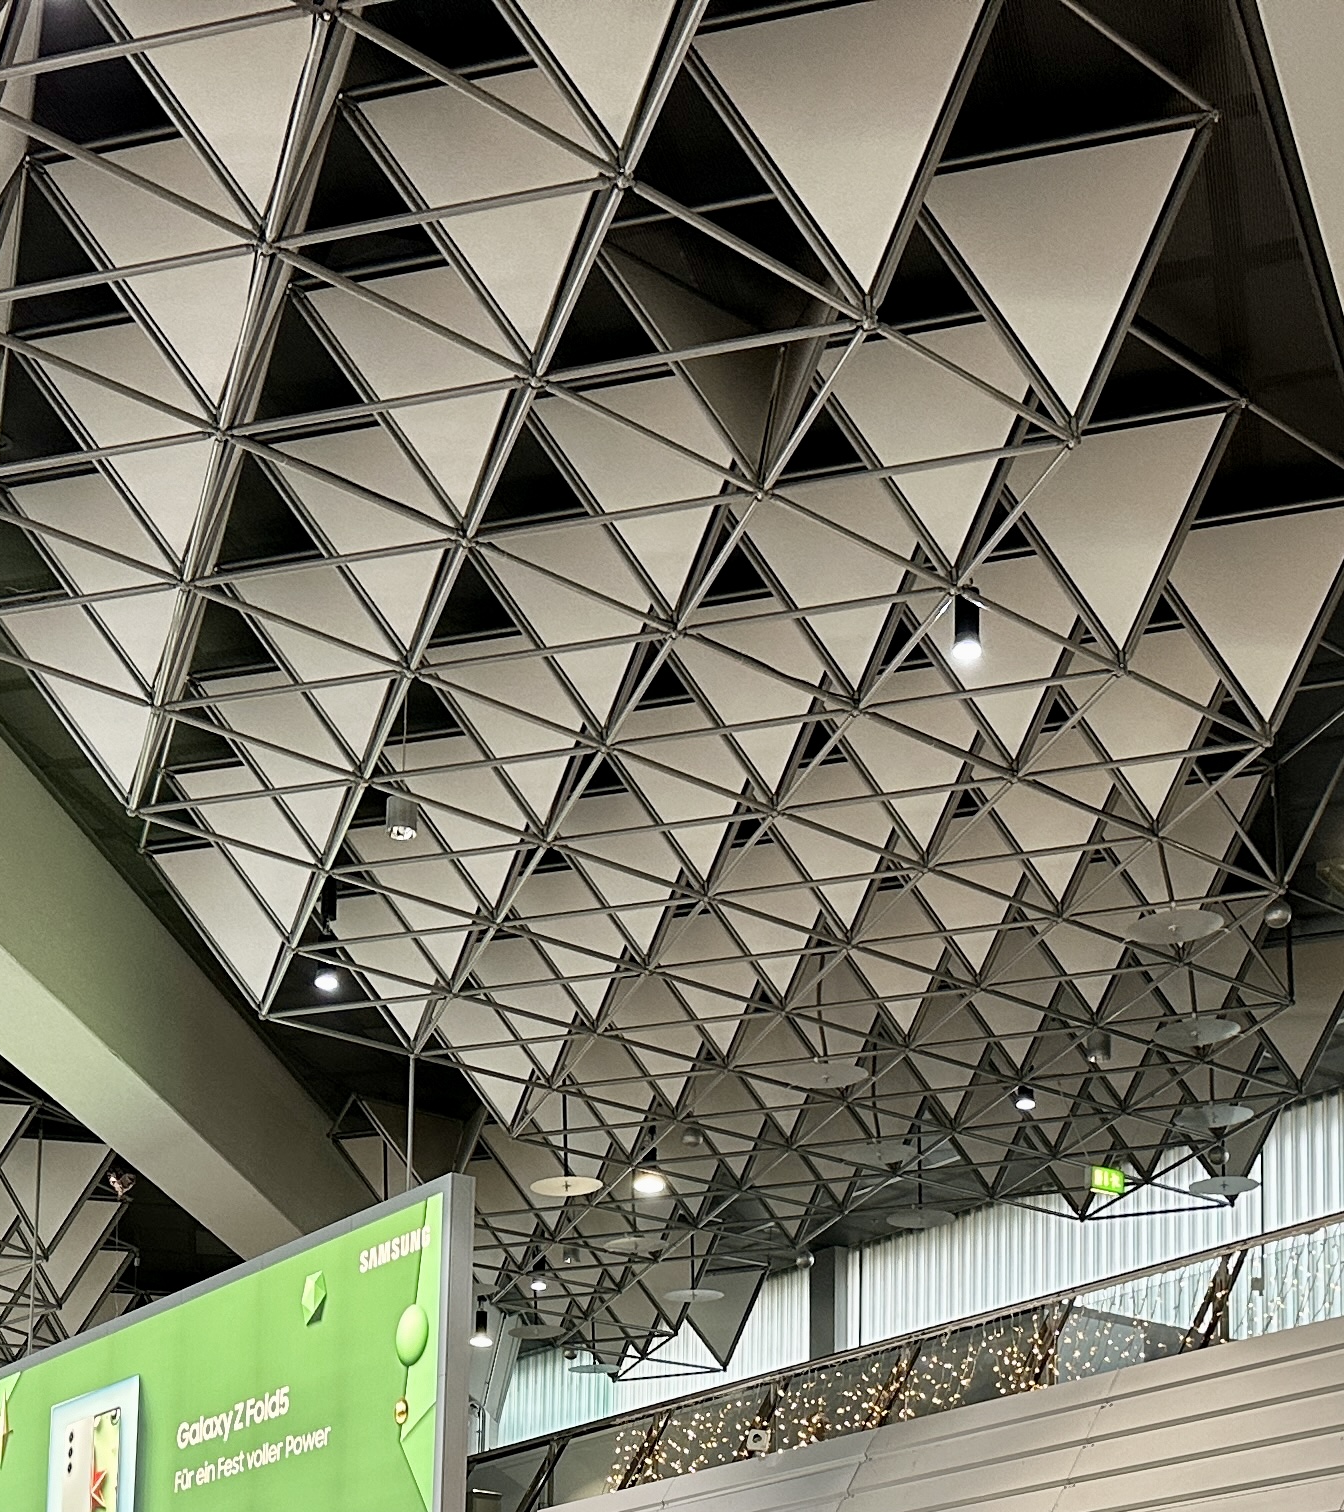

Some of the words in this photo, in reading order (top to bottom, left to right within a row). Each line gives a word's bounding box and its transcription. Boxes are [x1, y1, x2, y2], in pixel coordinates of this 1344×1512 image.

[359, 1224, 431, 1274] SAMSUNG
[177, 1410, 233, 1449] Galaxy
[234, 1402, 244, 1431] Z
[246, 1385, 290, 1427] Fold5
[174, 1467, 194, 1493] Für
[196, 1461, 215, 1486] ein
[217, 1450, 245, 1479] Fest
[246, 1442, 283, 1470] voller
[285, 1426, 332, 1458] Power
